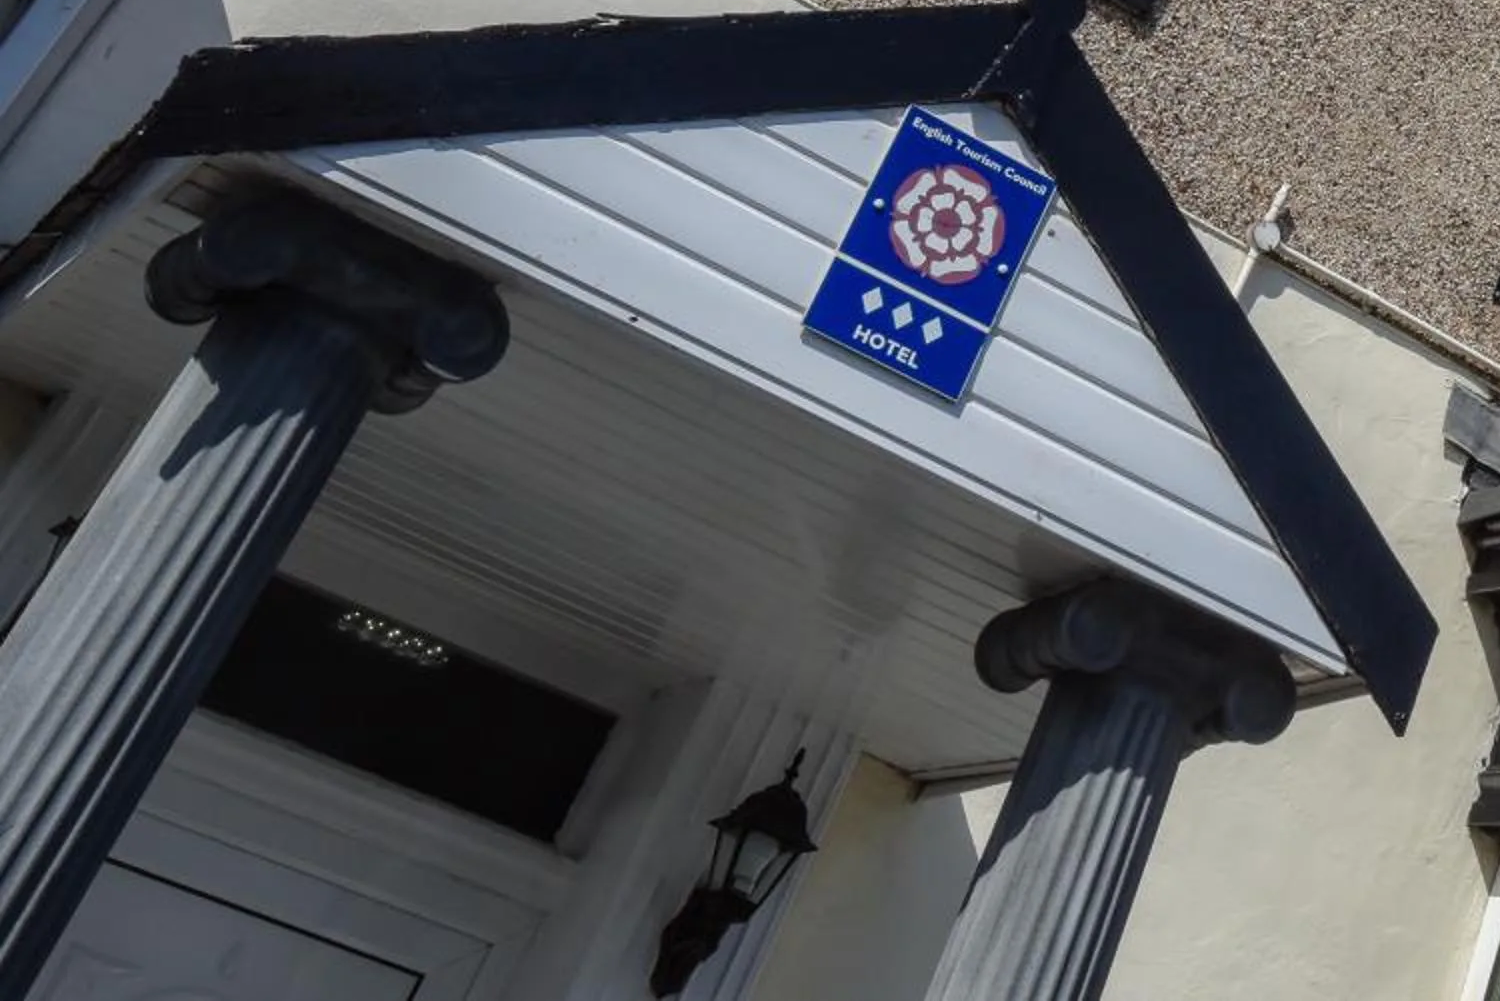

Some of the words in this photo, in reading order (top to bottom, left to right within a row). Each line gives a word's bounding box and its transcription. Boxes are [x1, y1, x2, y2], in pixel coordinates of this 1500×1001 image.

[912, 116, 953, 146] English
[956, 139, 1003, 172] Tourism
[1004, 165, 1047, 196] Council
[853, 324, 919, 370] HOTEL
